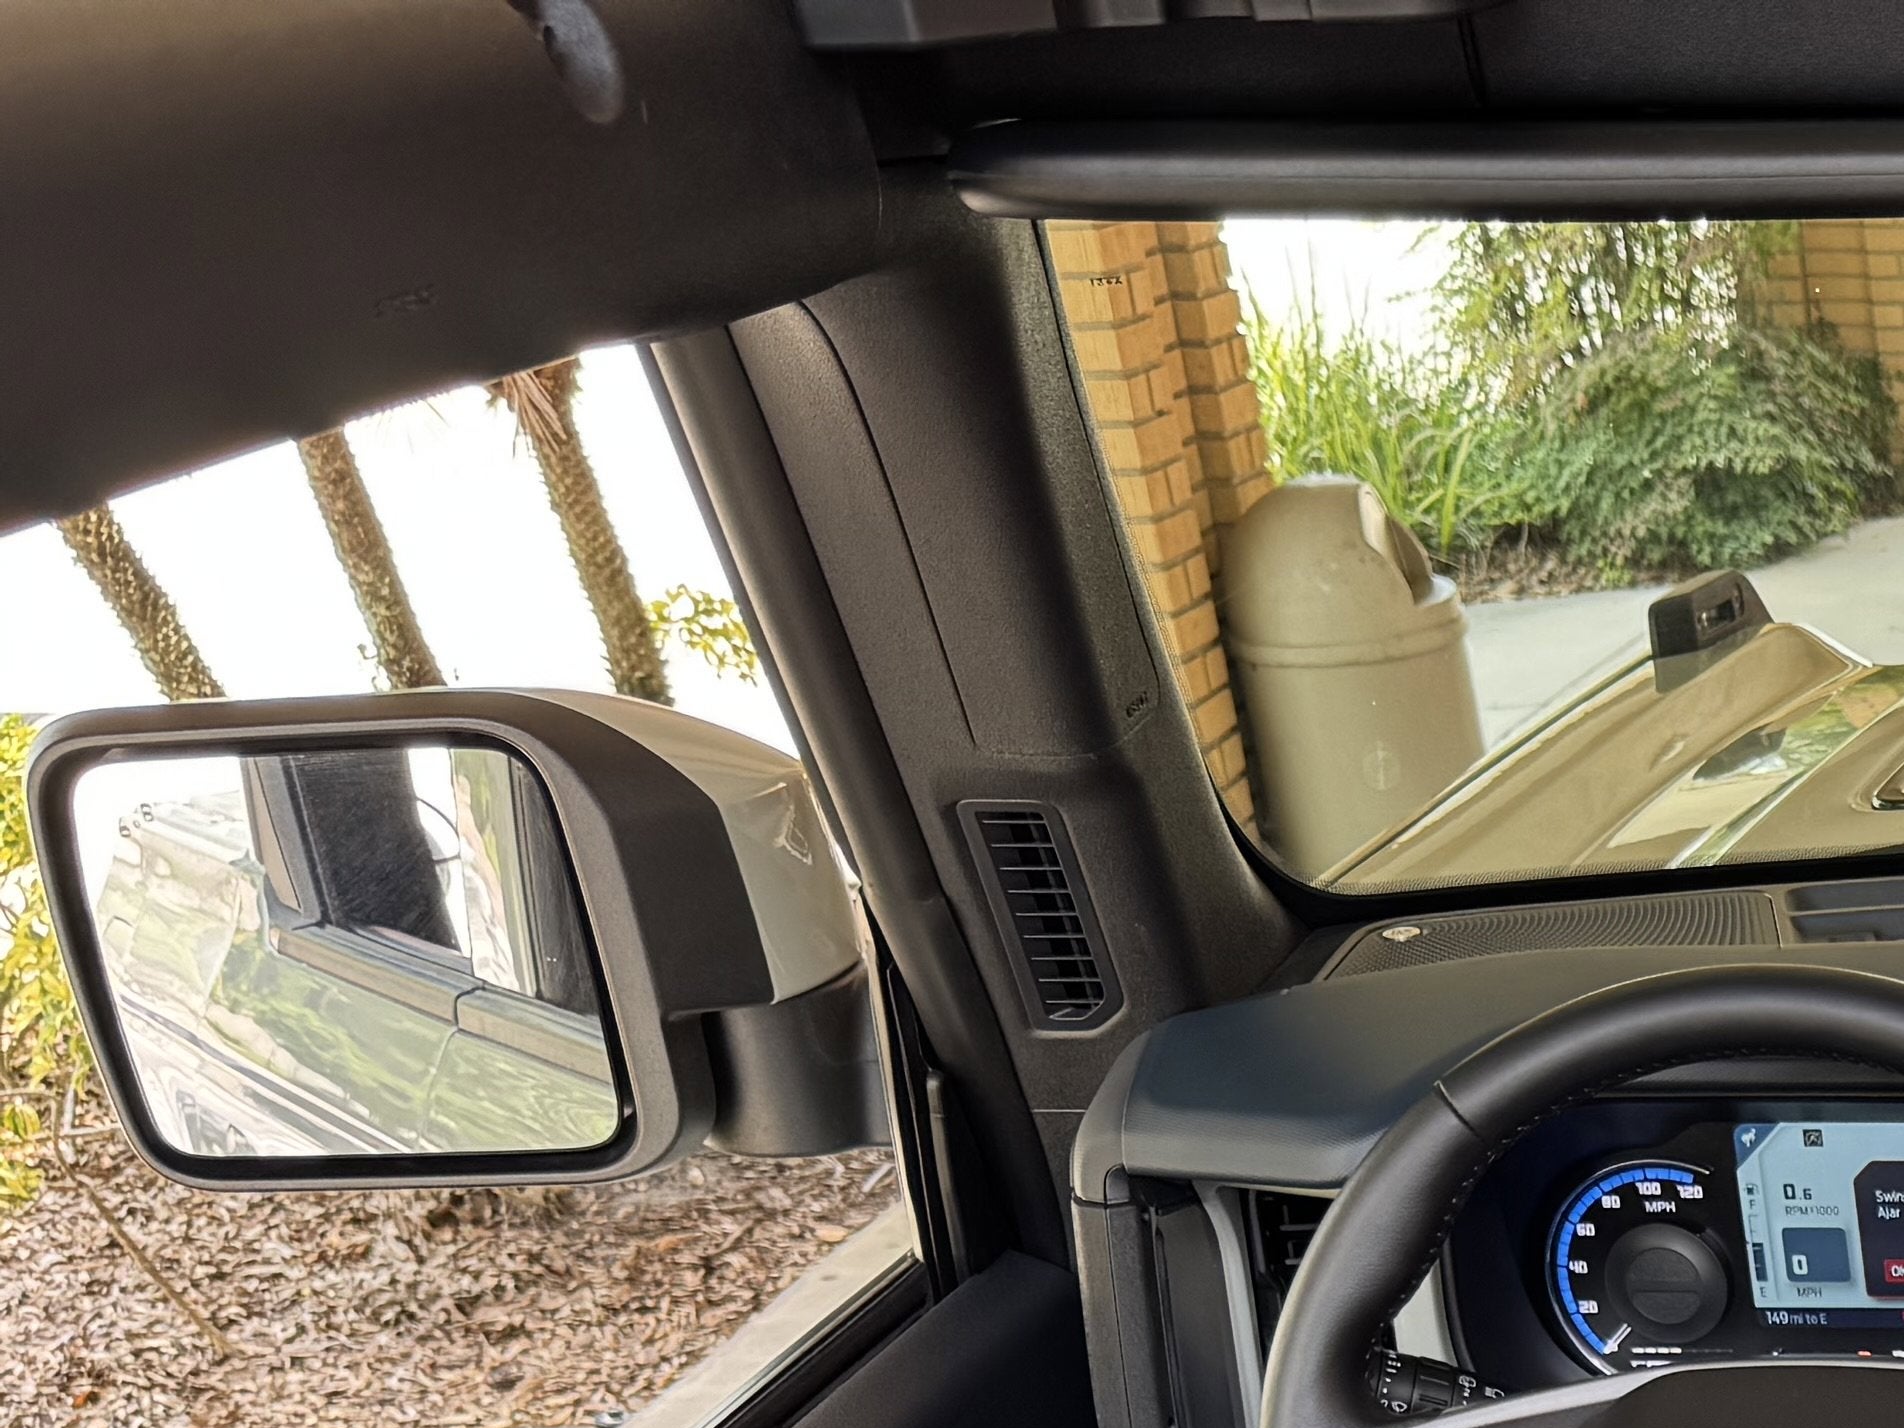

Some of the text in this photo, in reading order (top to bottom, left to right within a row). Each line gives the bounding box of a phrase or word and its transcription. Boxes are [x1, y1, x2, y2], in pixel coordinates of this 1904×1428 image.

[1634, 1182, 1661, 1196] 100
[1676, 1184, 1703, 1199] 120
[1783, 1184, 1812, 1200] 0.6
[1601, 1195, 1620, 1209] 80
[1645, 1201, 1676, 1213] MPH
[1877, 1206, 1900, 1220] Ajar
[1576, 1223, 1595, 1236] 60
[1569, 1260, 1588, 1274] 40
[1792, 1255, 1808, 1275] 0
[1579, 1300, 1599, 1314] 20
[1805, 1313, 1818, 1325] to
[1819, 1313, 1828, 1325] E
